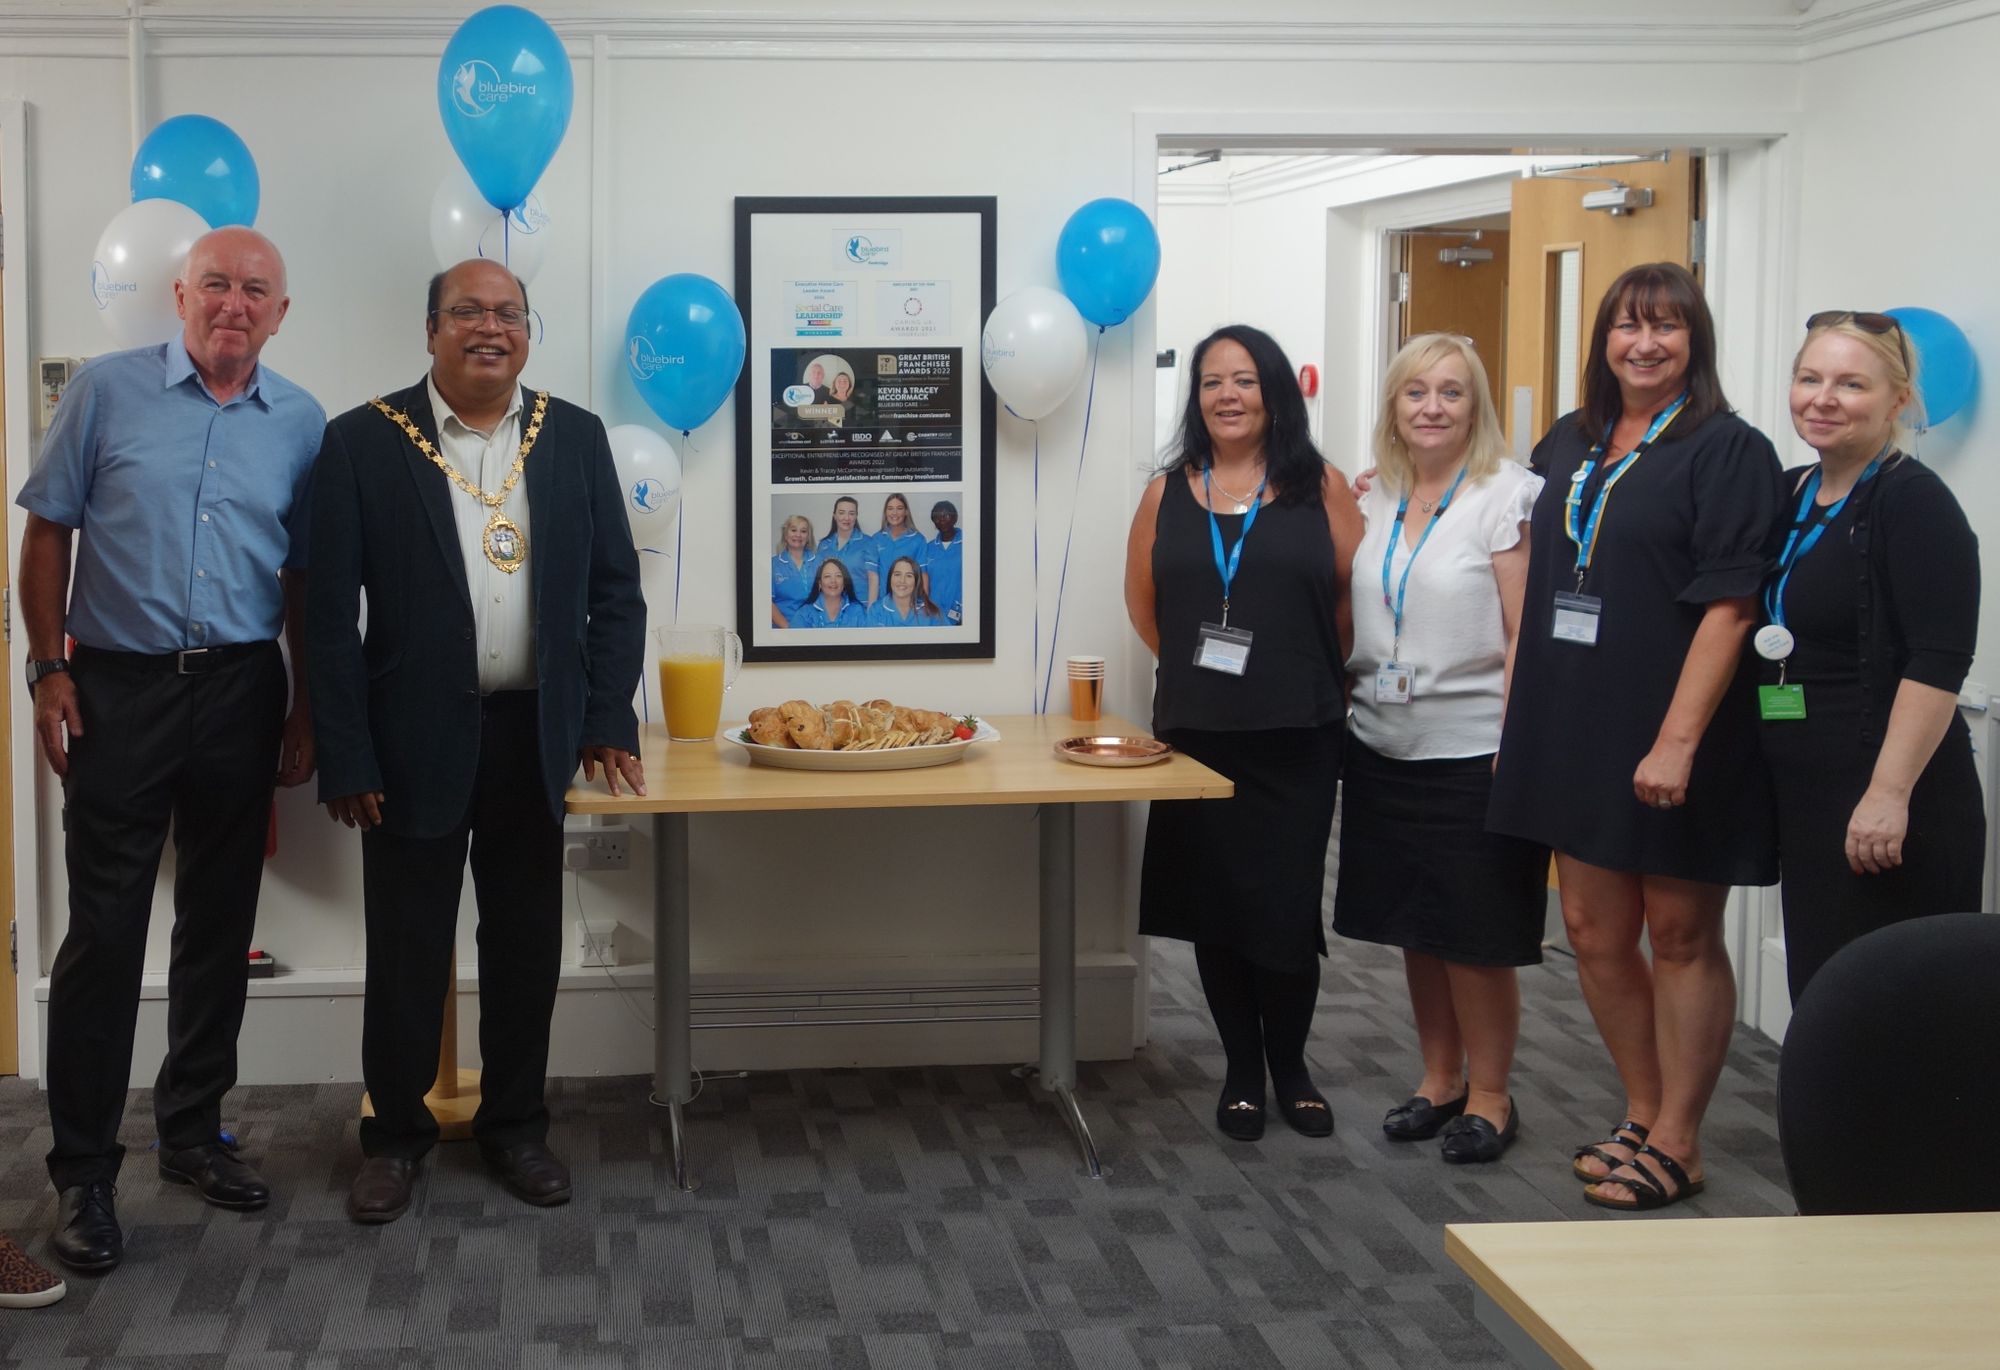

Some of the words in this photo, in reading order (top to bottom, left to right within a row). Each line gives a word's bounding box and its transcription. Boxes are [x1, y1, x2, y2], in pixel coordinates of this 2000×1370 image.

[478, 80, 536, 95] bluebird
[478, 93, 509, 102] care
[795, 304, 822, 312] Social
[823, 304, 844, 312] Care
[640, 353, 685, 364] bluebird
[910, 386, 939, 394] TRACEY
[804, 407, 838, 415] WINNER
